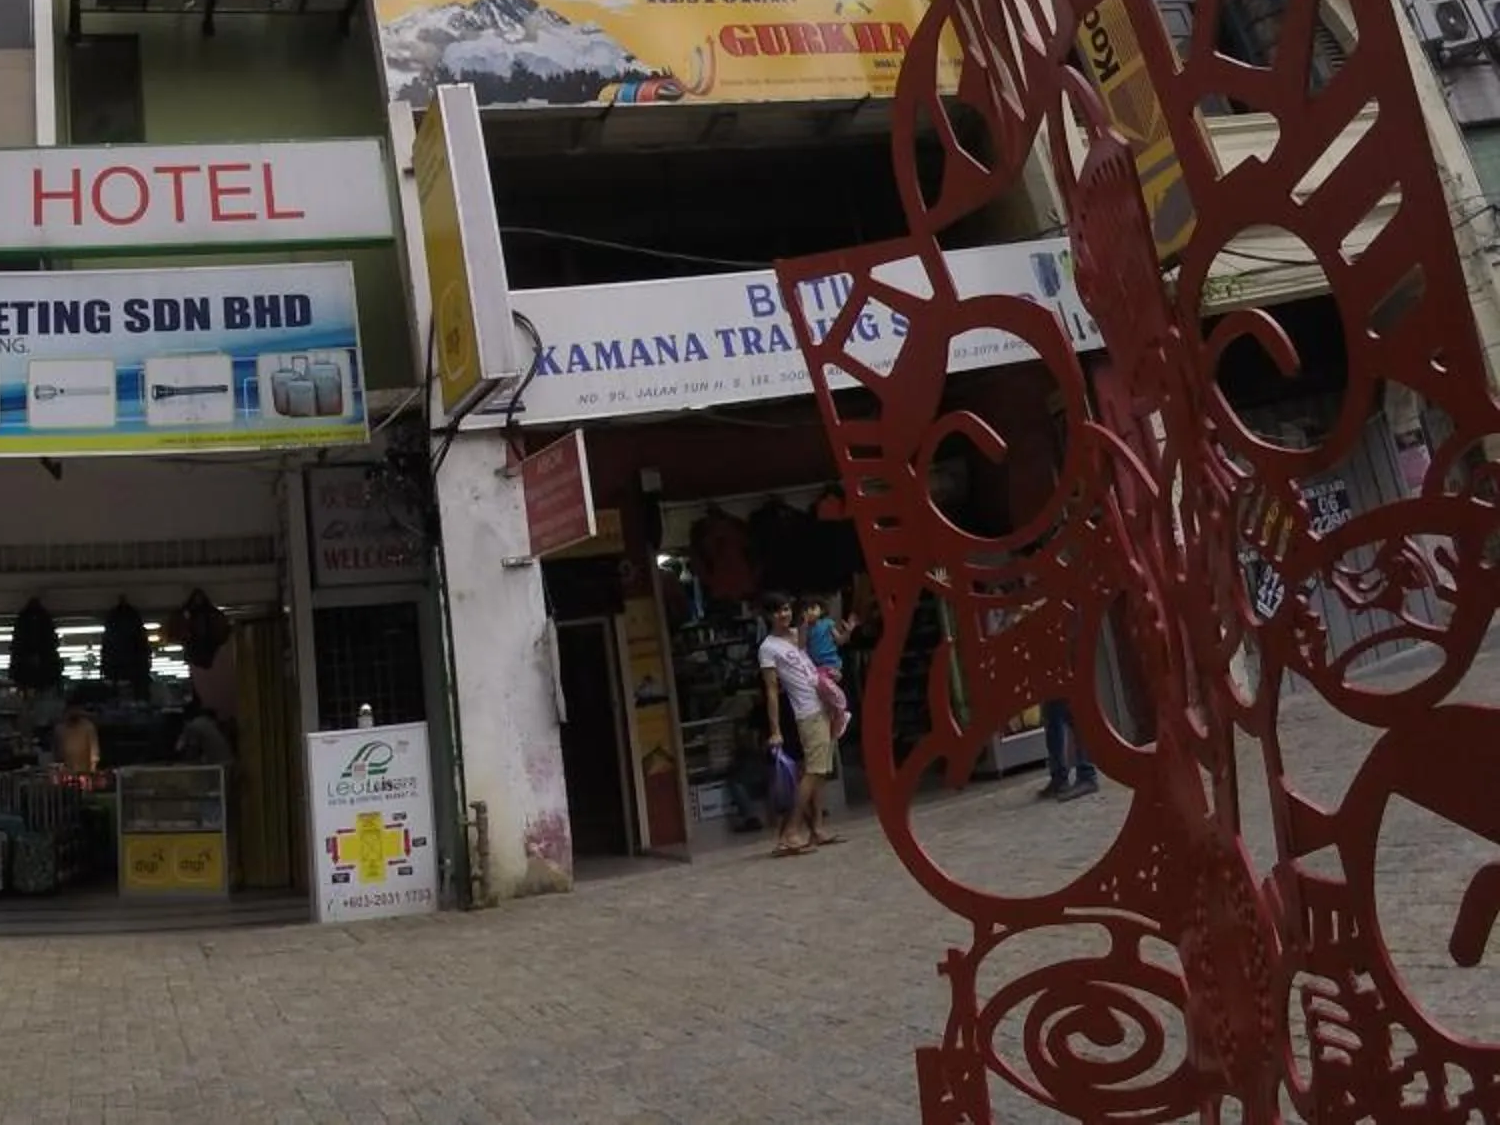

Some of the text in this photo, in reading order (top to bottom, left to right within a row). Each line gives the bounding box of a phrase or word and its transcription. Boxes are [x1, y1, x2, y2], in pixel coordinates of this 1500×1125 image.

[719, 22, 912, 57] GURKHA
[32, 162, 305, 226] HOTEL
[124, 296, 212, 334] SDN
[223, 293, 312, 330] BHD
[533, 332, 709, 377] KAMANA
[636, 386, 678, 400] JALAN
